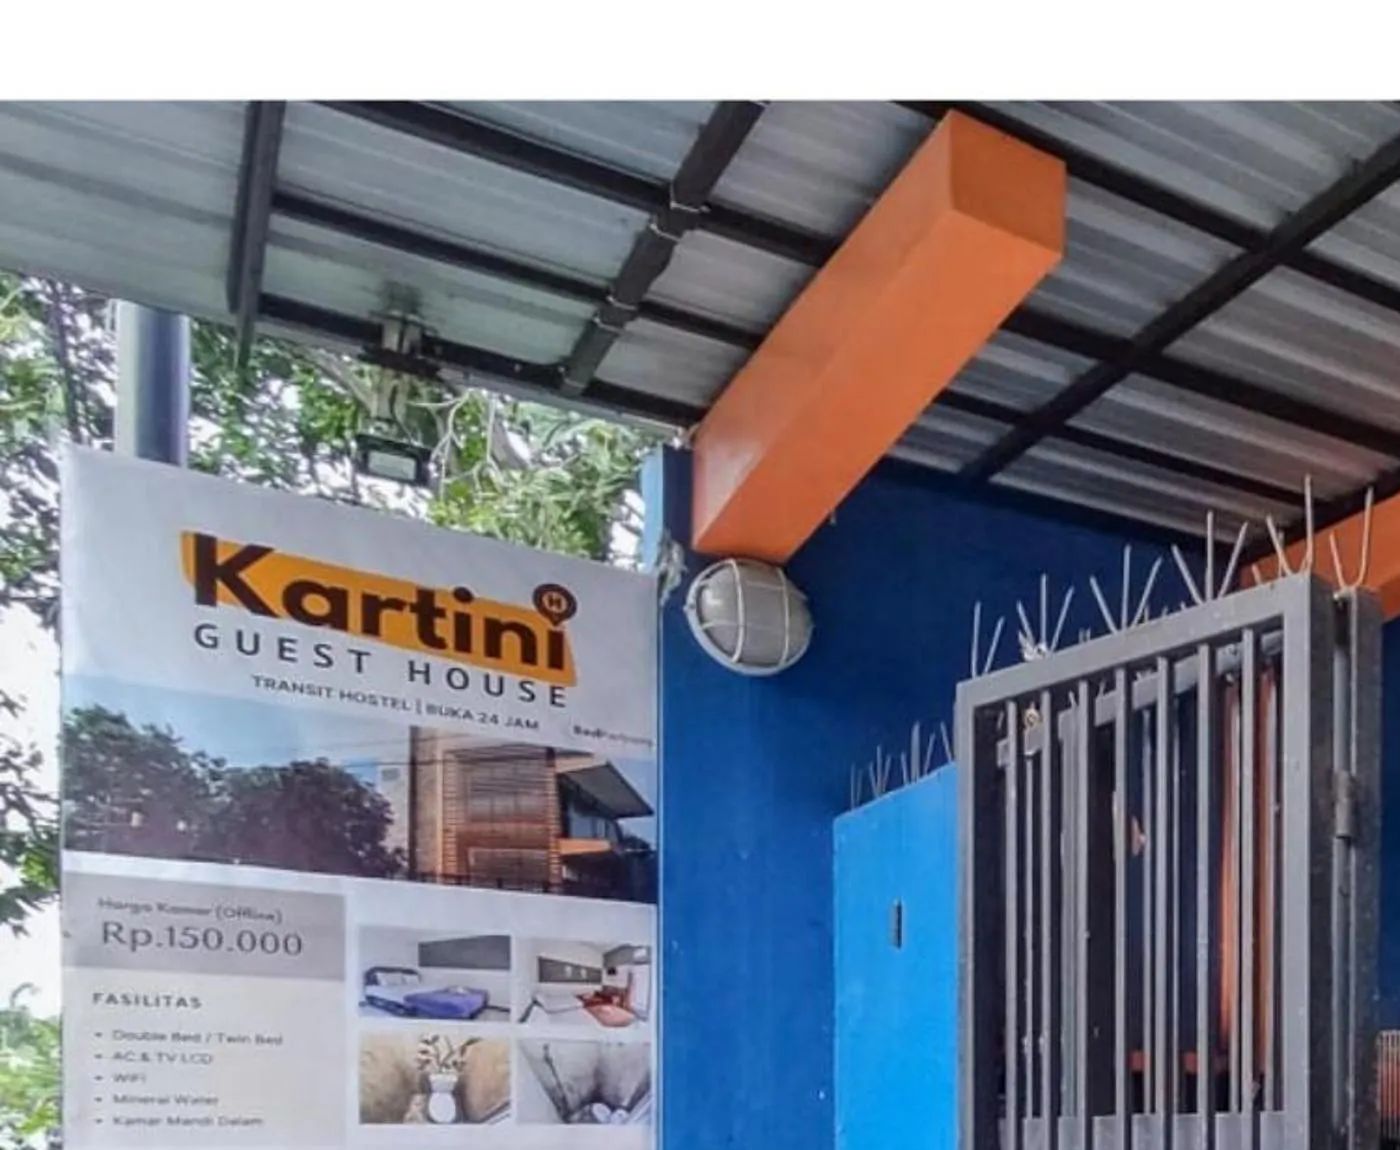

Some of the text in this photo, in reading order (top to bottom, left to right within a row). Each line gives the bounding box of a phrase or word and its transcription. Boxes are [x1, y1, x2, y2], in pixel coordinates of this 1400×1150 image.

[195, 532, 577, 671] Kartini
[194, 622, 568, 708] GUEST HOUSE
[251, 674, 335, 700] TRANSIT
[339, 688, 412, 712] HOSTEL
[425, 702, 475, 721] BUKA
[477, 711, 500, 725] 24
[505, 716, 540, 731] JAM
[98, 897, 152, 915] Harga
[102, 920, 303, 956] Rp.150.000
[92, 992, 202, 1010] FASILITAS
[112, 1030, 167, 1042] Double
[171, 1032, 202, 1044] Bed
[217, 1032, 251, 1045] Twin
[255, 1034, 283, 1046] Bed
[112, 1051, 136, 1062] AC
[156, 1052, 176, 1064] TV
[182, 1053, 213, 1065] LCD
